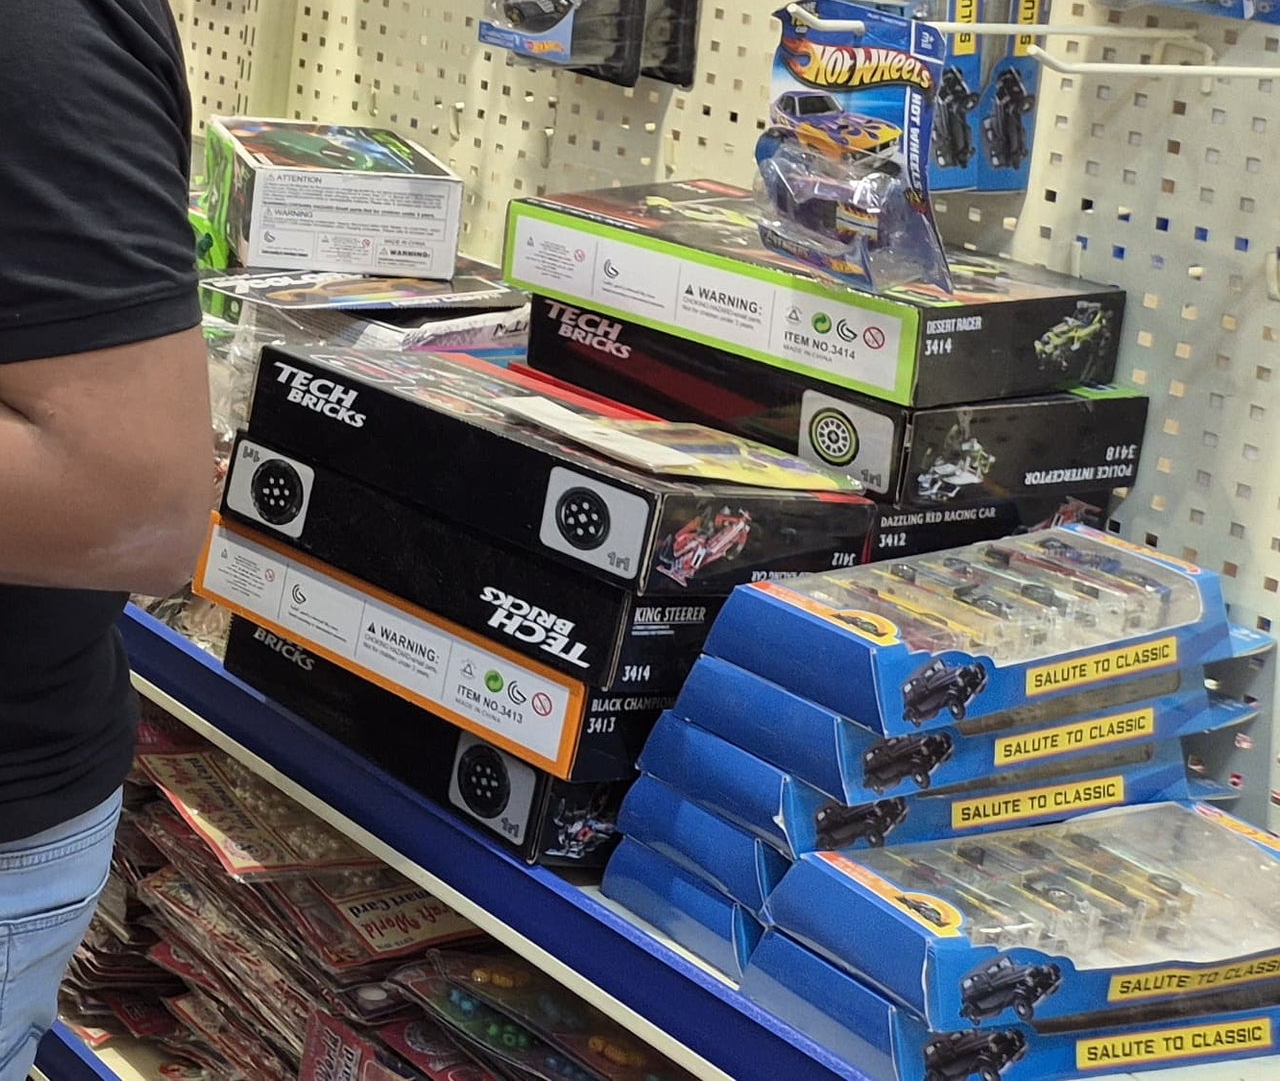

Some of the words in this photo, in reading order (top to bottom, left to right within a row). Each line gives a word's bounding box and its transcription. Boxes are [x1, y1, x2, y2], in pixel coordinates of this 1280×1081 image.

[808, 44, 855, 86] HOT
[854, 47, 932, 89] WHEELS
[911, 93, 923, 127] HOT
[909, 129, 923, 190] WHEELS
[276, 173, 322, 184] ATTENTION
[274, 209, 313, 219] WARNING
[698, 286, 763, 317] WARNING:
[543, 299, 624, 340] TECH
[926, 319, 955, 335] DESERT
[955, 315, 982, 332] RACER
[557, 326, 632, 360] BRICKS
[784, 331, 810, 349] ITEM
[812, 338, 857, 361] NO.3414
[924, 339, 952, 355] 3414
[273, 361, 359, 408] TECH
[287, 388, 367, 429] BRICKS
[1024, 467, 1095, 486] INTERCEPTOR
[1096, 464, 1133, 481] POLICE
[880, 513, 924, 528] DAZZLING
[925, 512, 942, 526] RED
[943, 509, 976, 524] RACING
[977, 507, 996, 520] CAR
[879, 533, 907, 548] 3412
[831, 552, 857, 567] 3412
[479, 585, 576, 634] BRICKS
[633, 607, 662, 623] KING
[663, 606, 707, 623] STEERER
[252, 627, 315, 671] BRICKS
[379, 624, 441, 666] WARNING:
[487, 608, 591, 669] TECH
[622, 664, 651, 682] 3414
[1034, 663, 1088, 688] SALUTE
[1094, 658, 1111, 673] TO
[1116, 645, 1170, 670] CLASSIC
[457, 684, 478, 706] ITEM
[480, 694, 523, 724] NO.3413
[591, 697, 623, 712] BLACK
[587, 717, 616, 734] 3413
[1003, 734, 1060, 758] SALUTE
[1066, 729, 1084, 744] TO
[1089, 717, 1146, 741] CLASSIC
[961, 799, 1021, 821] SALUTE
[1028, 795, 1047, 809] TO
[1053, 784, 1116, 806] CLASSIC
[349, 892, 391, 918] Card
[1119, 974, 1191, 995] SALUTE
[1197, 971, 1219, 985] TO
[1087, 1039, 1156, 1062] SALUTE
[1162, 1035, 1184, 1052] TO
[1191, 1026, 1263, 1047] CLASSIC
